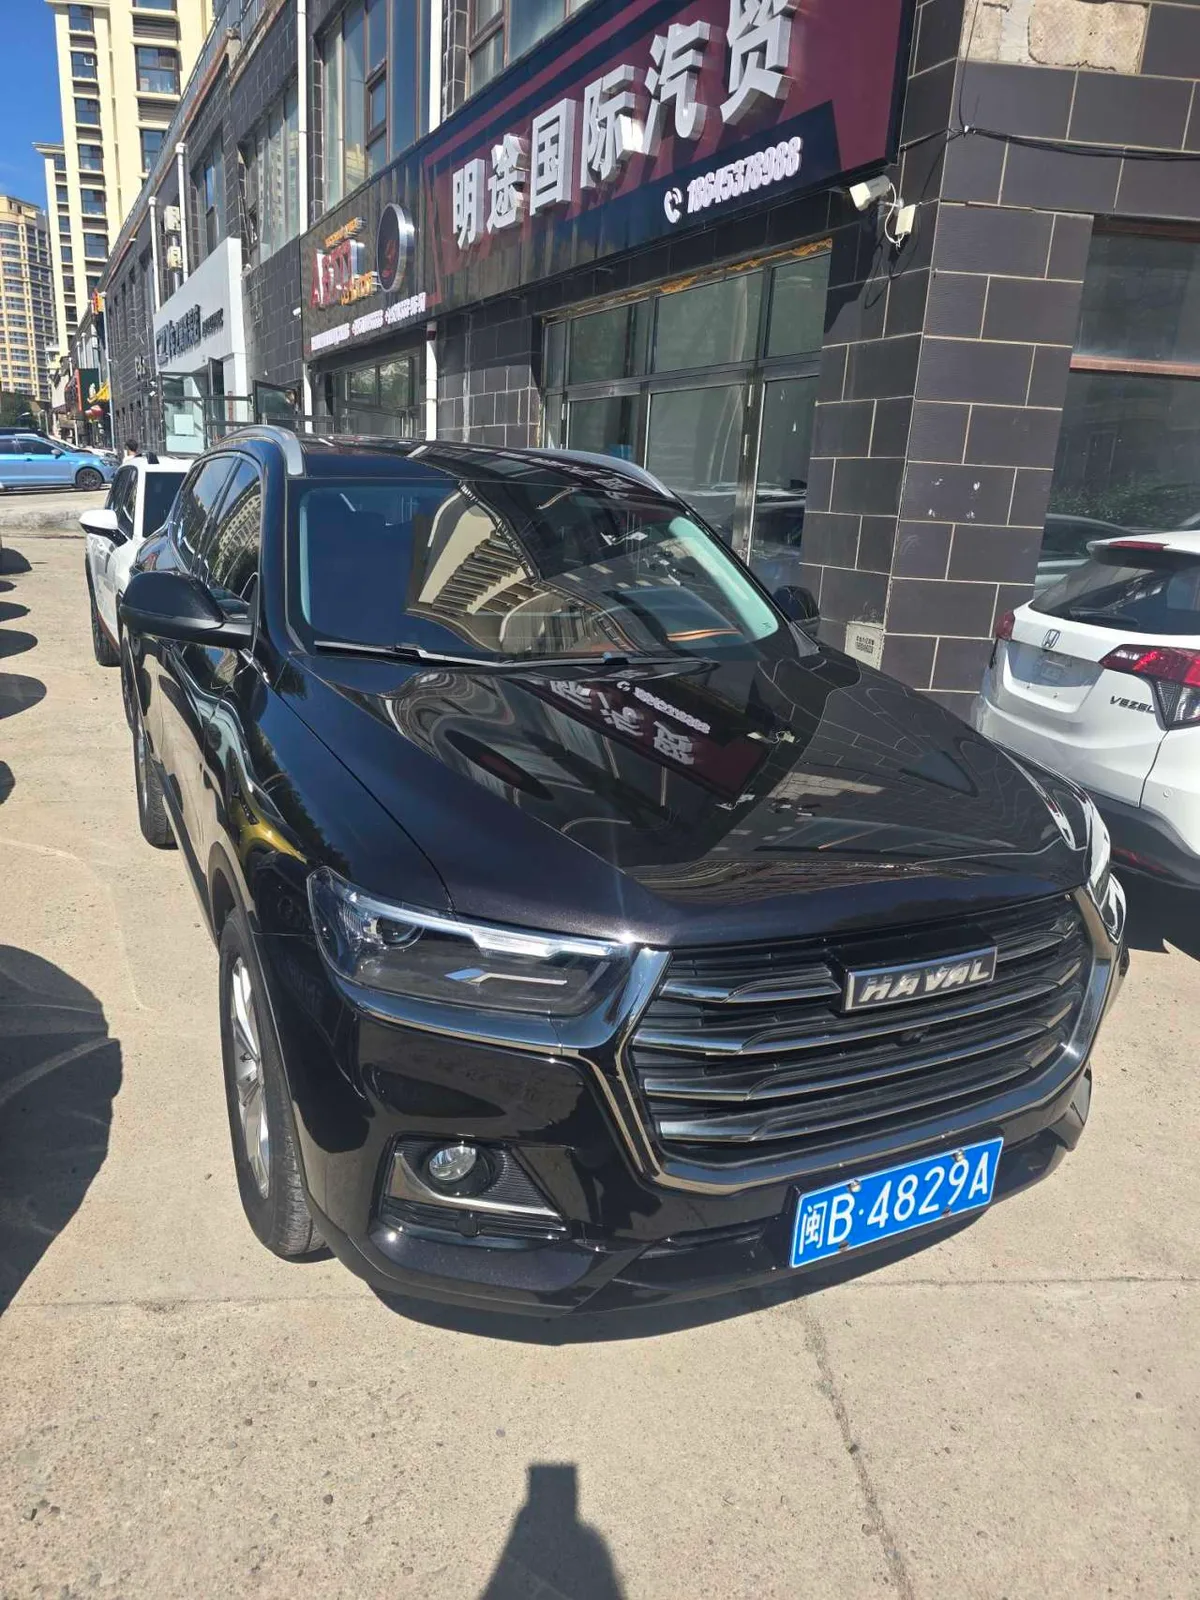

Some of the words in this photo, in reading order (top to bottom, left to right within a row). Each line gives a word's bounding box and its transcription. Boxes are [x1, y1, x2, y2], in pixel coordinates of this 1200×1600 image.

[453, 0, 796, 250] 明途国际汽贸
[858, 959, 992, 1003] HAVAL
[798, 1151, 990, 1255] 闽B·4829A
